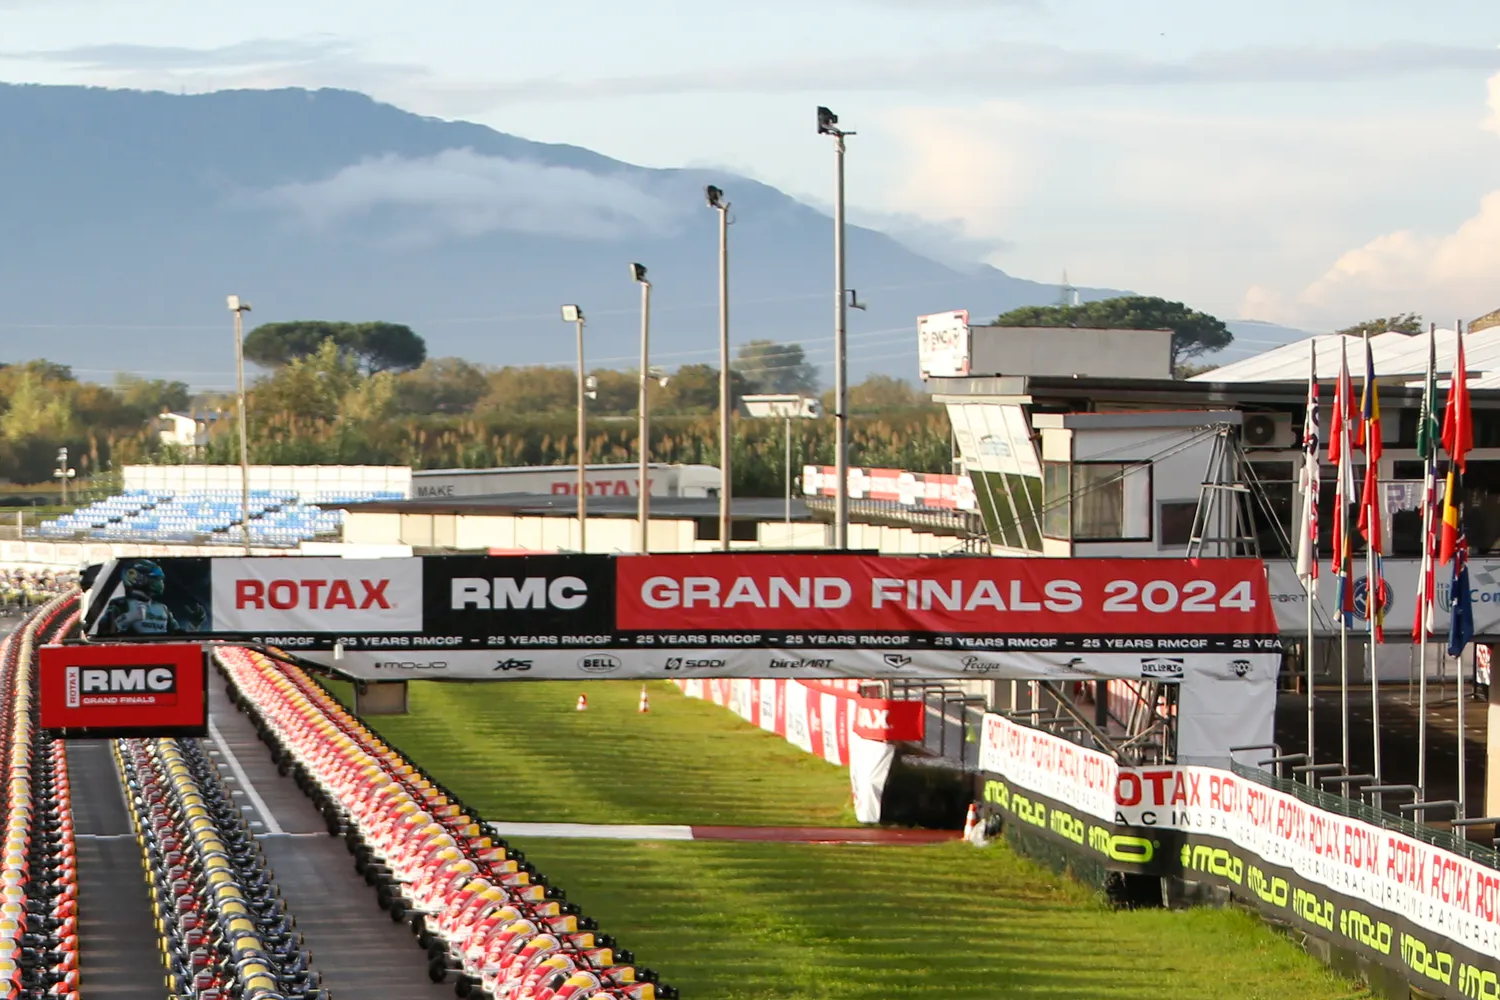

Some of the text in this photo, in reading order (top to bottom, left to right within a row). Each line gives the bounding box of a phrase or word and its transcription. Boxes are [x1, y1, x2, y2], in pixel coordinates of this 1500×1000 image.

[417, 485, 455, 498] MAKE
[235, 579, 390, 609] ROTAX
[451, 576, 588, 610] RMC
[641, 576, 1256, 612] GRAND FINALS 2024
[265, 637, 314, 646] RMCGF
[337, 636, 357, 646] 25
[362, 636, 409, 646] YEARS
[413, 636, 463, 645] RMCGF
[487, 636, 506, 645] 25
[510, 635, 558, 645] YEARS
[562, 635, 612, 645] RMCGF
[636, 635, 654, 644] 25
[658, 635, 707, 644] YEARS
[711, 635, 761, 644] RMCGF
[785, 635, 804, 644] 25
[808, 635, 856, 645] YEARS
[860, 635, 910, 645] RMCGF
[934, 637, 953, 646] 25
[956, 638, 1004, 647] YEARS
[1008, 638, 1058, 648] RMCGF
[1082, 639, 1101, 648] 25
[1105, 638, 1154, 648] YEARS
[1158, 639, 1208, 648] RMCGF
[1233, 639, 1250, 648] 25
[583, 659, 615, 668] BELL
[685, 659, 725, 668] SODI
[961, 655, 1000, 673] Praga
[68, 671, 77, 704] ROTAX
[83, 668, 174, 692] RMC
[83, 696, 156, 705] GRAND FINALS
[1114, 770, 1200, 807] OTAX
[1344, 825, 1380, 877] ROTAX
[1386, 837, 1427, 894] ROTAX
[1431, 854, 1473, 914] ROTAX
